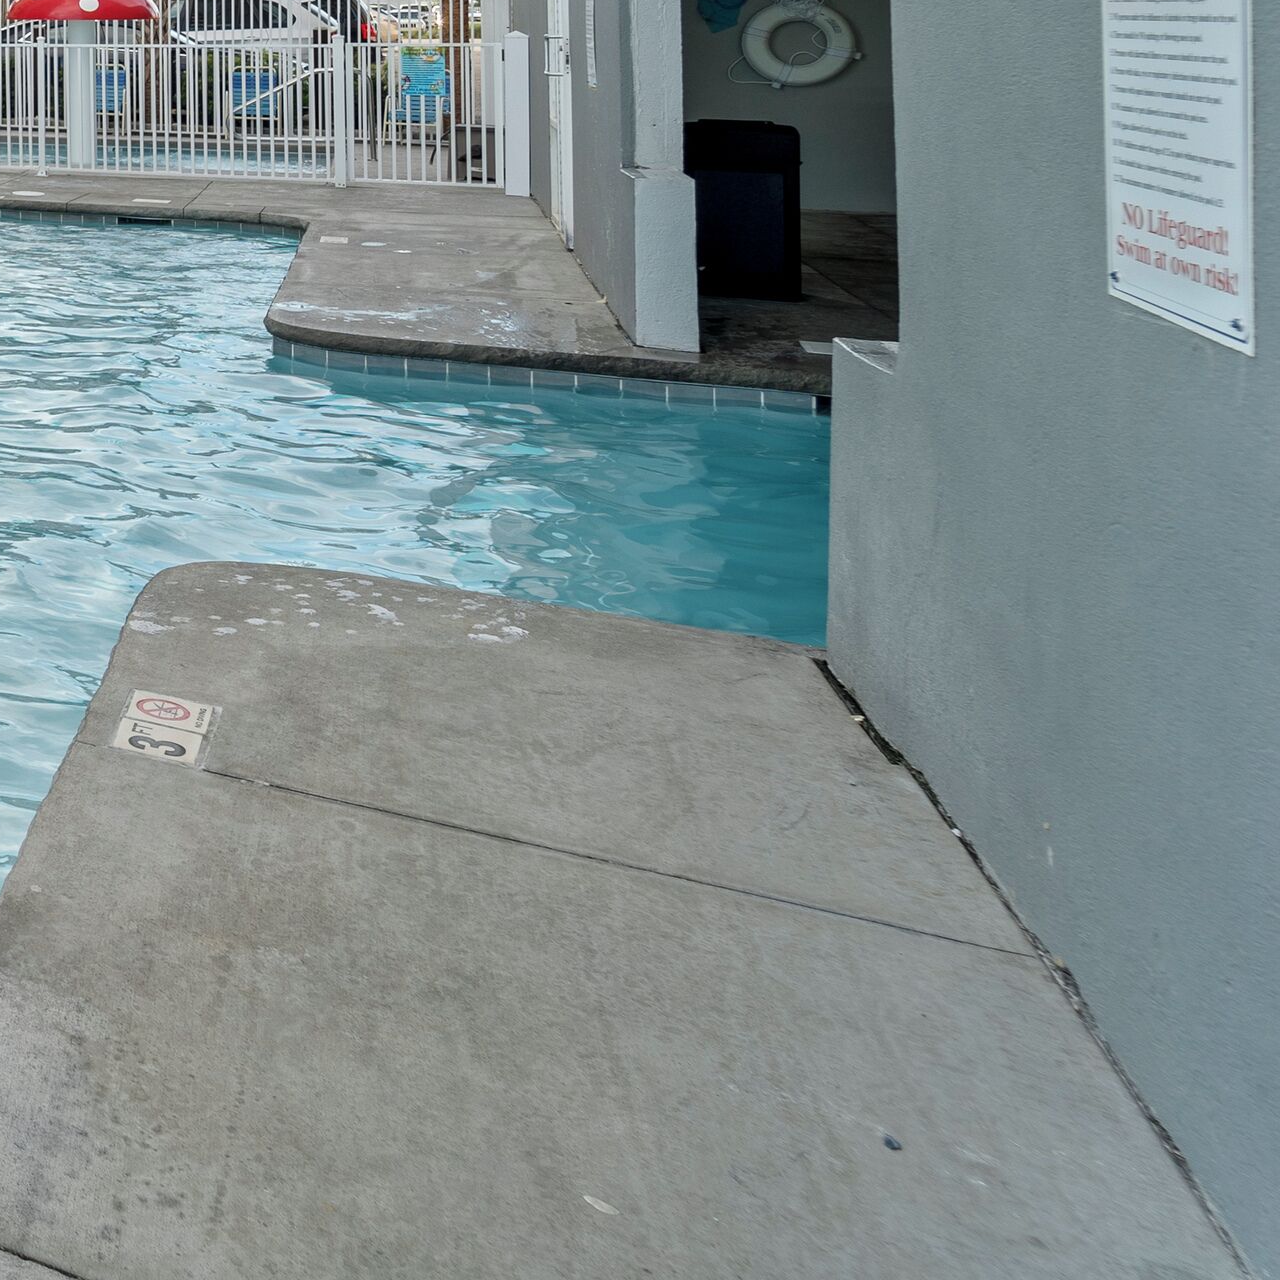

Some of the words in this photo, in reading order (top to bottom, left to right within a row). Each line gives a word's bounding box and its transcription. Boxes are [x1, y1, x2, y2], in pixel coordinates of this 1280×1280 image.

[1121, 202, 1144, 229] NO
[1147, 209, 1229, 255] Lifeguard!
[1116, 234, 1152, 265] Swim
[1154, 250, 1167, 270] at
[1170, 256, 1201, 283] own
[1204, 264, 1239, 296] risk!
[128, 735, 186, 757] 3
